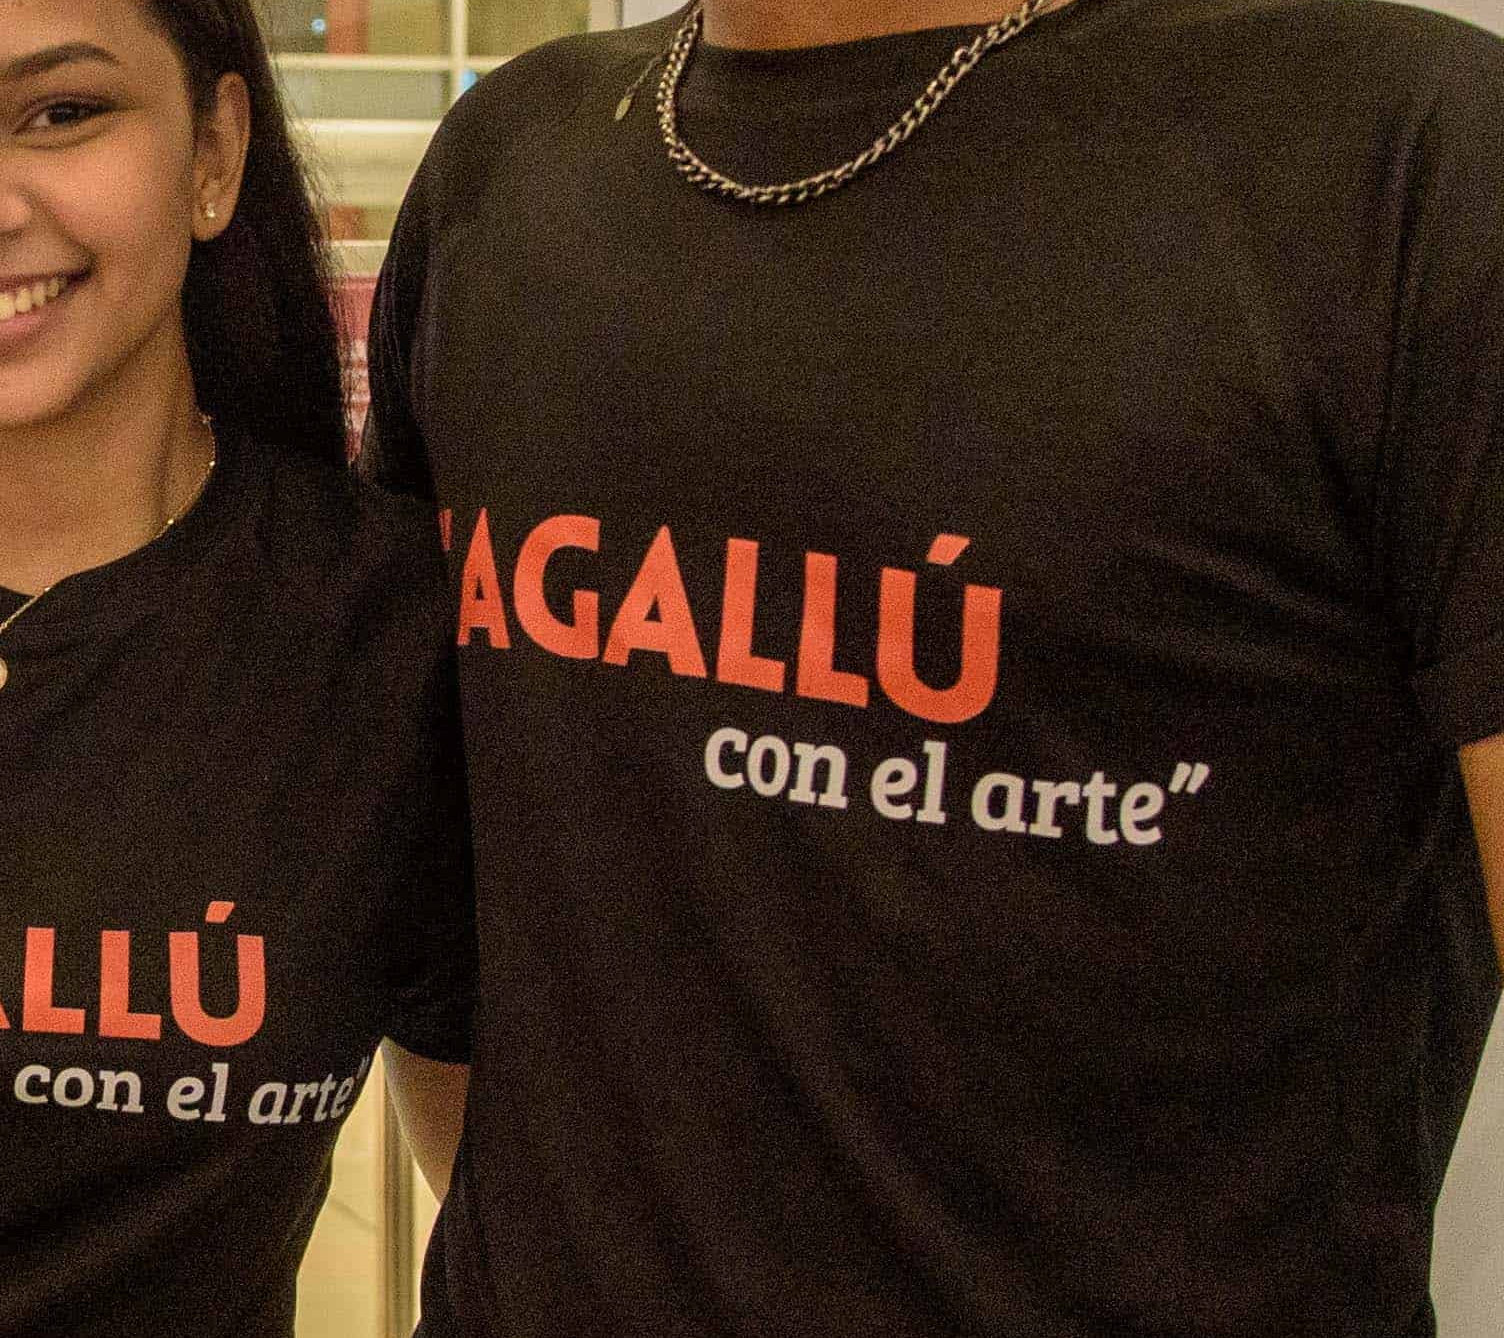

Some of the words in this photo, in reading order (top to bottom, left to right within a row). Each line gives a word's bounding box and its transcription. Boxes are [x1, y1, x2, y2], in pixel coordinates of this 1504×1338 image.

[703, 726, 848, 810] con
[870, 740, 948, 825] el
[13, 1064, 144, 1114] con
[166, 1062, 230, 1122] el
